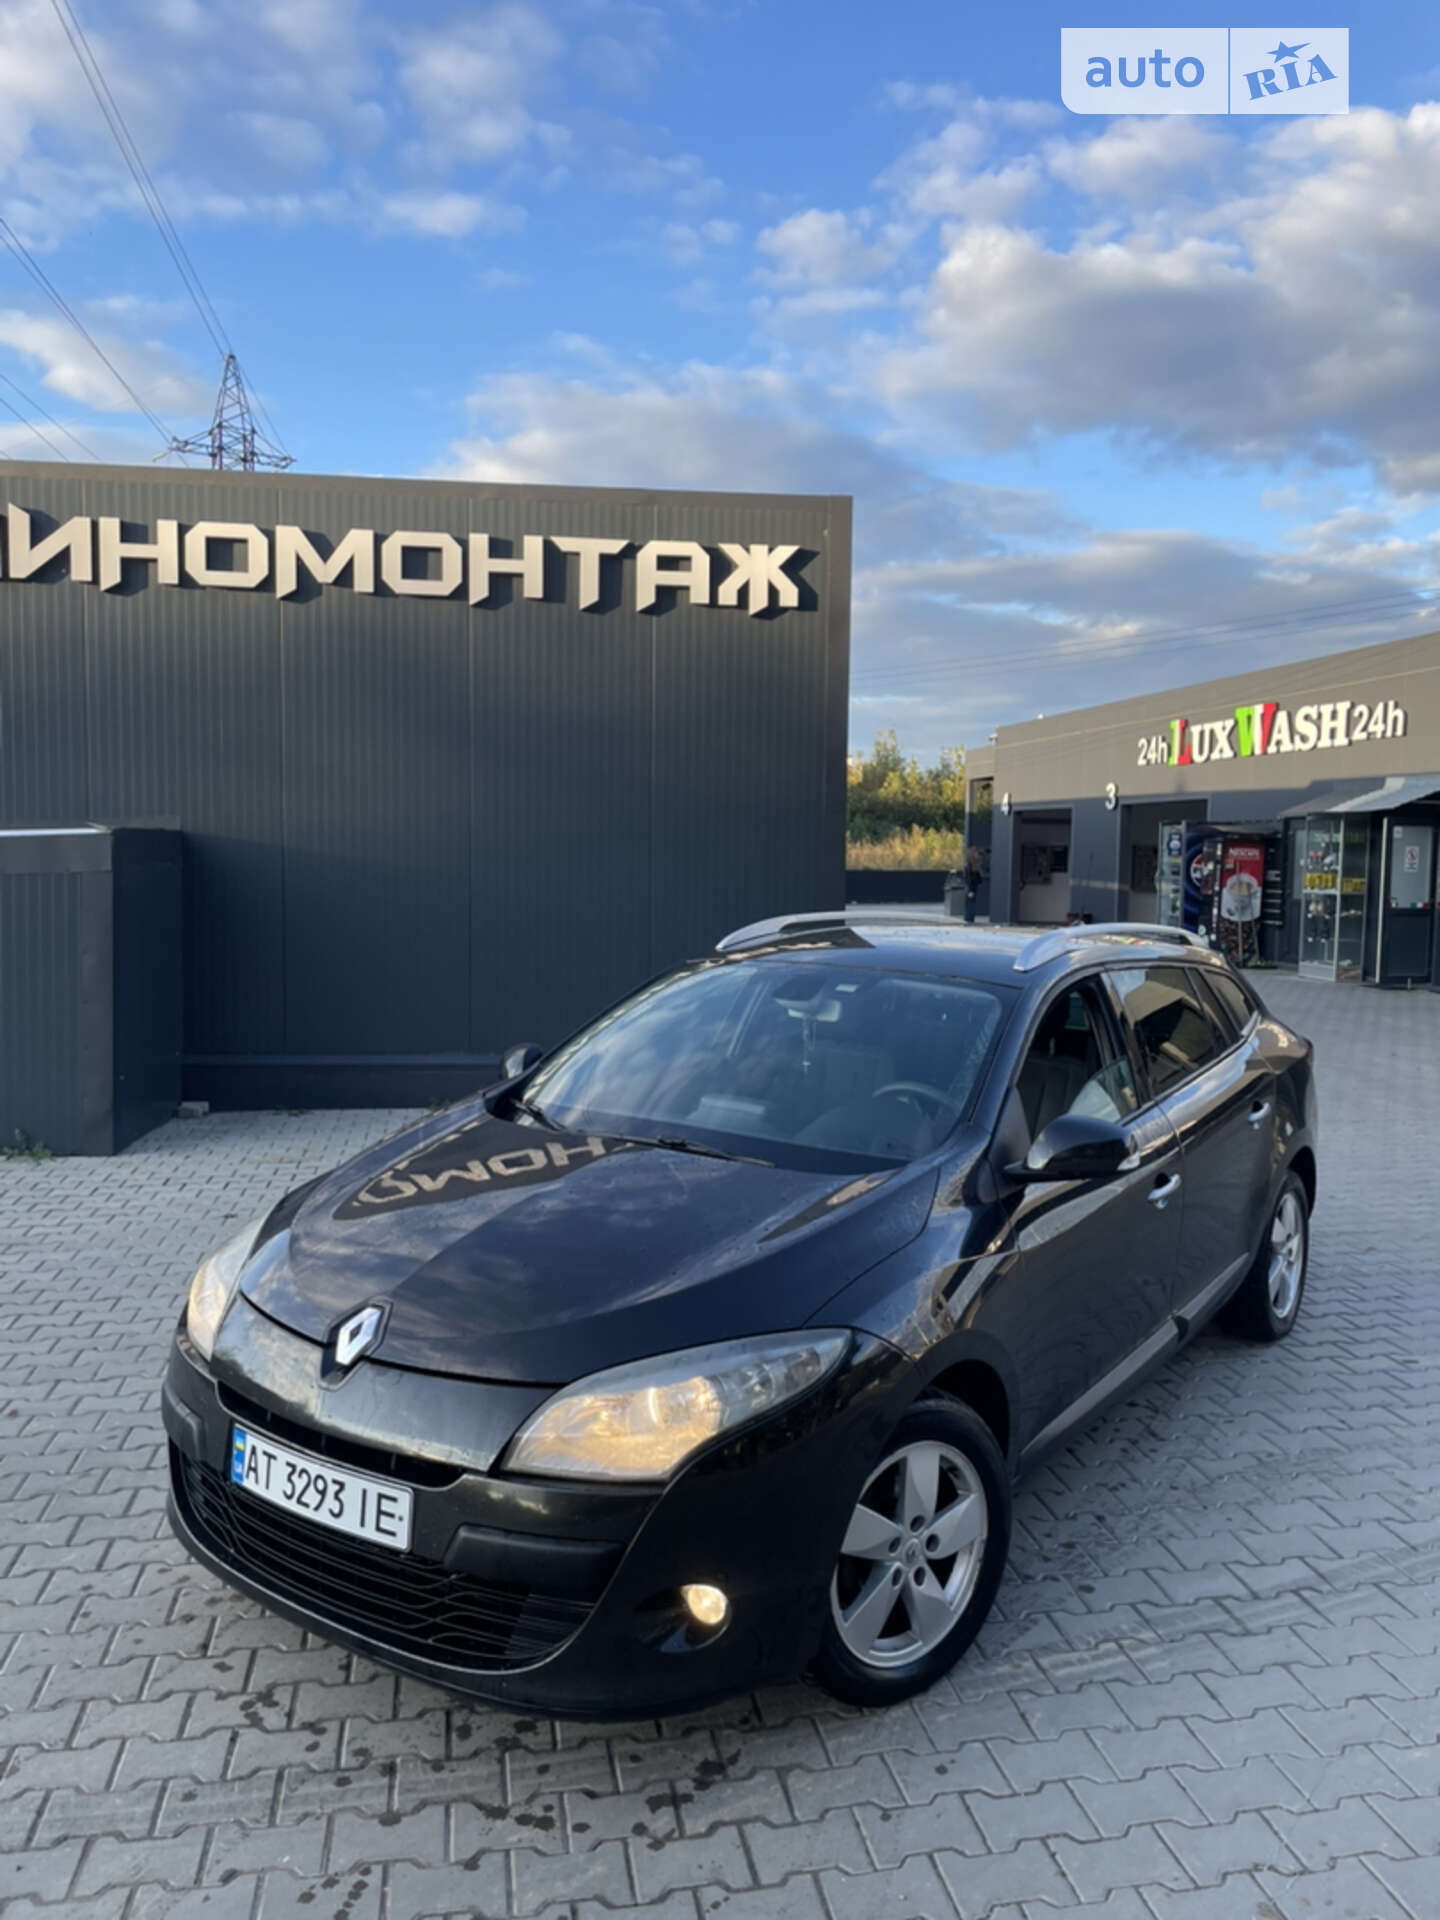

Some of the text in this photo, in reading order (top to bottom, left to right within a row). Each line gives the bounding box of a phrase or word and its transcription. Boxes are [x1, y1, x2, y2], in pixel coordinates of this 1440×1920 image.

[0, 501, 800, 616] ИНОМОНТАЖ
[1137, 700, 1405, 766] 24h LUX WASH 24h
[1001, 791, 1011, 816] 4
[1105, 782, 1117, 810] 3
[245, 1444, 399, 1537] AT 3293 IE
